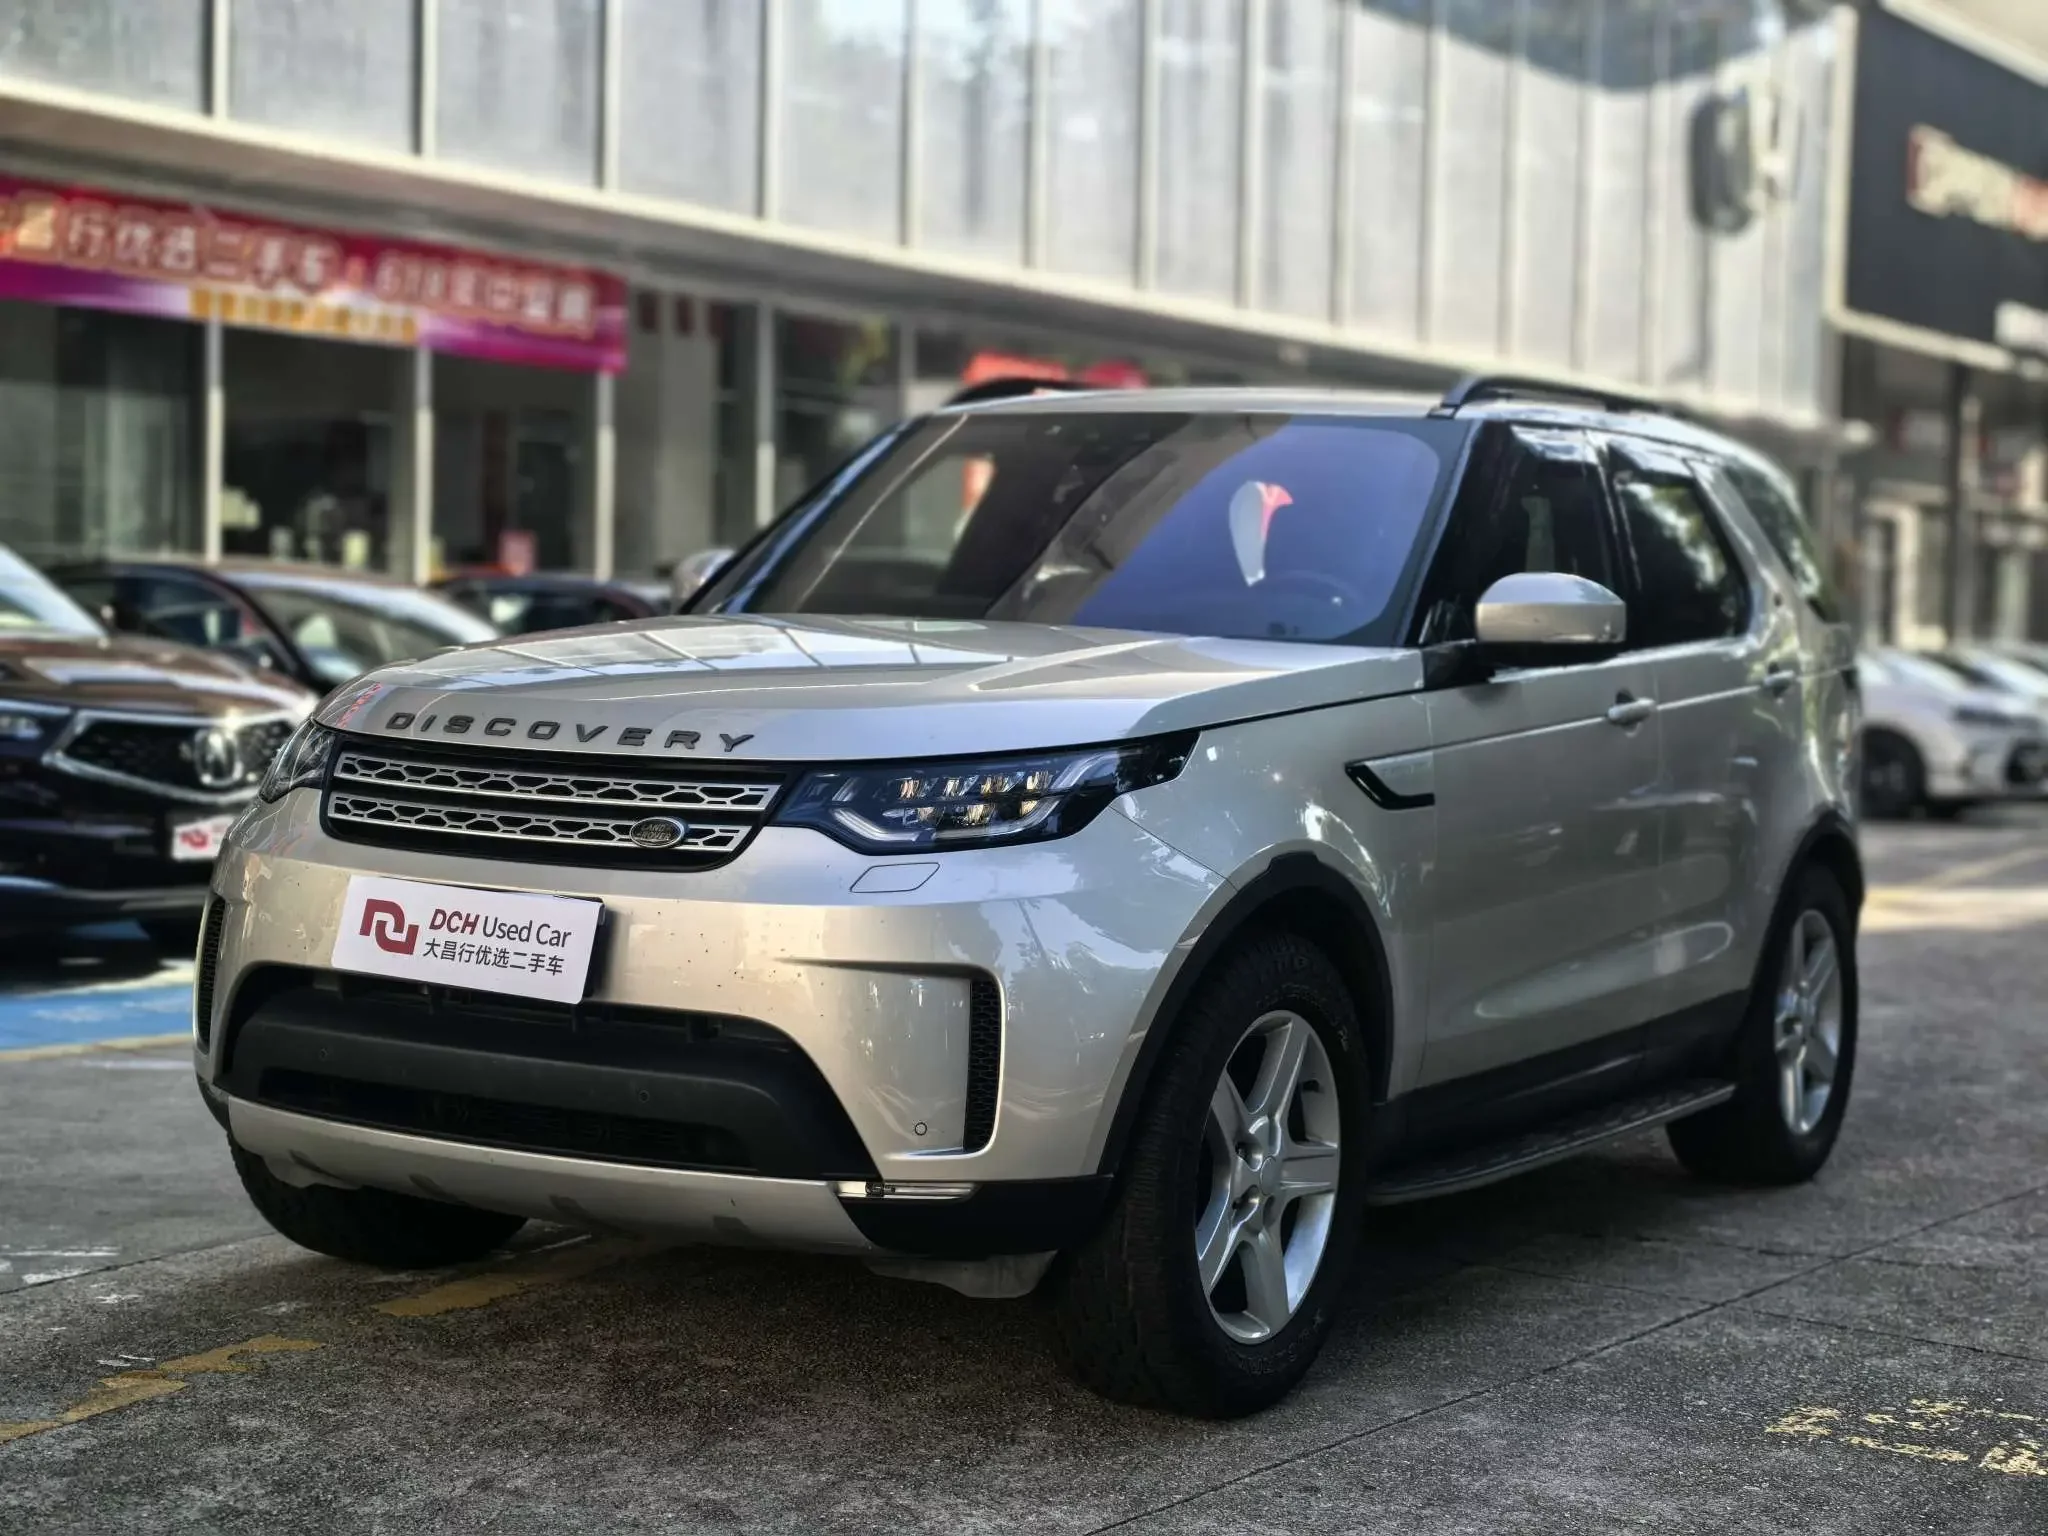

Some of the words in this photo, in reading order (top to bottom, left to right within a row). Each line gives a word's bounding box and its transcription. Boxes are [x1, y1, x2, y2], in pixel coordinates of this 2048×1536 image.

[386, 712, 755, 752] DISCOVERY
[429, 908, 480, 935] DCH
[482, 915, 533, 942] Used
[536, 923, 572, 948] Car
[423, 938, 565, 976] 大昌行优选二手车
